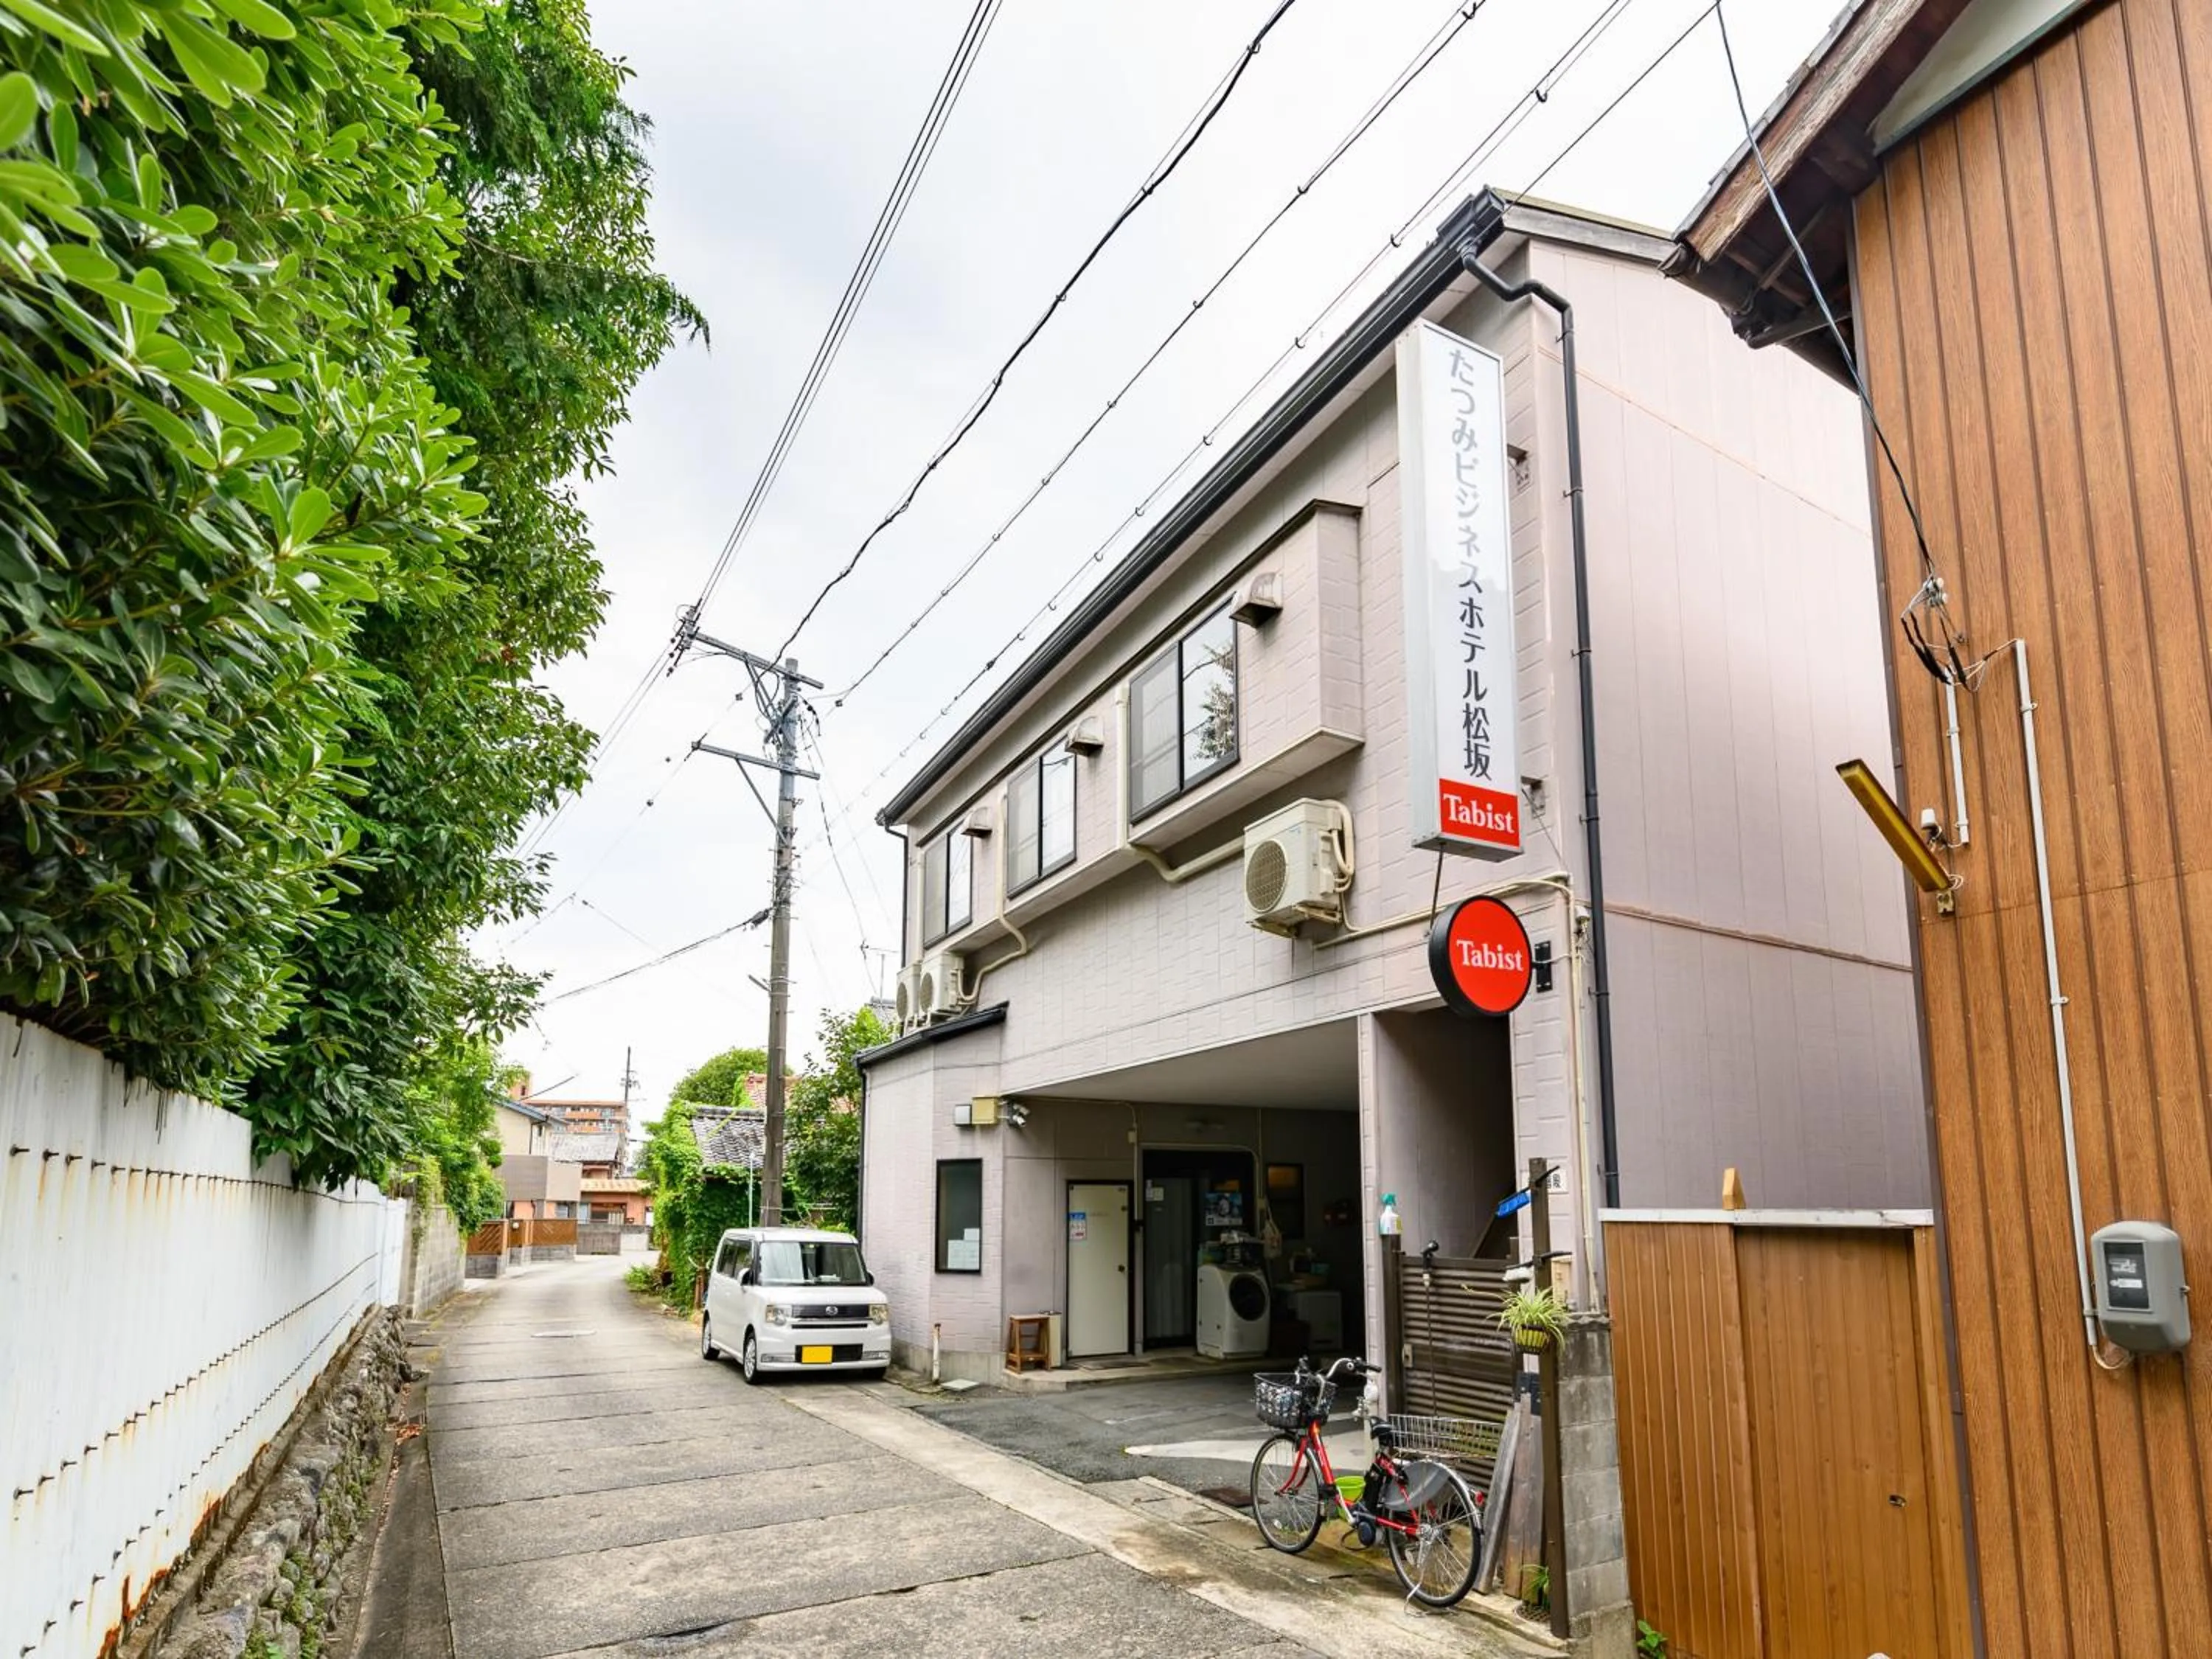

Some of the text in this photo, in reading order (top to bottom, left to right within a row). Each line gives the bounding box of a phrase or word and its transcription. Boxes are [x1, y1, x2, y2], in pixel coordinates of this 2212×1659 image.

[1449, 349, 1492, 781] たつみビジネスホテル松坂
[1443, 793, 1515, 835] Tabist
[1457, 939, 1523, 972] Tabist
